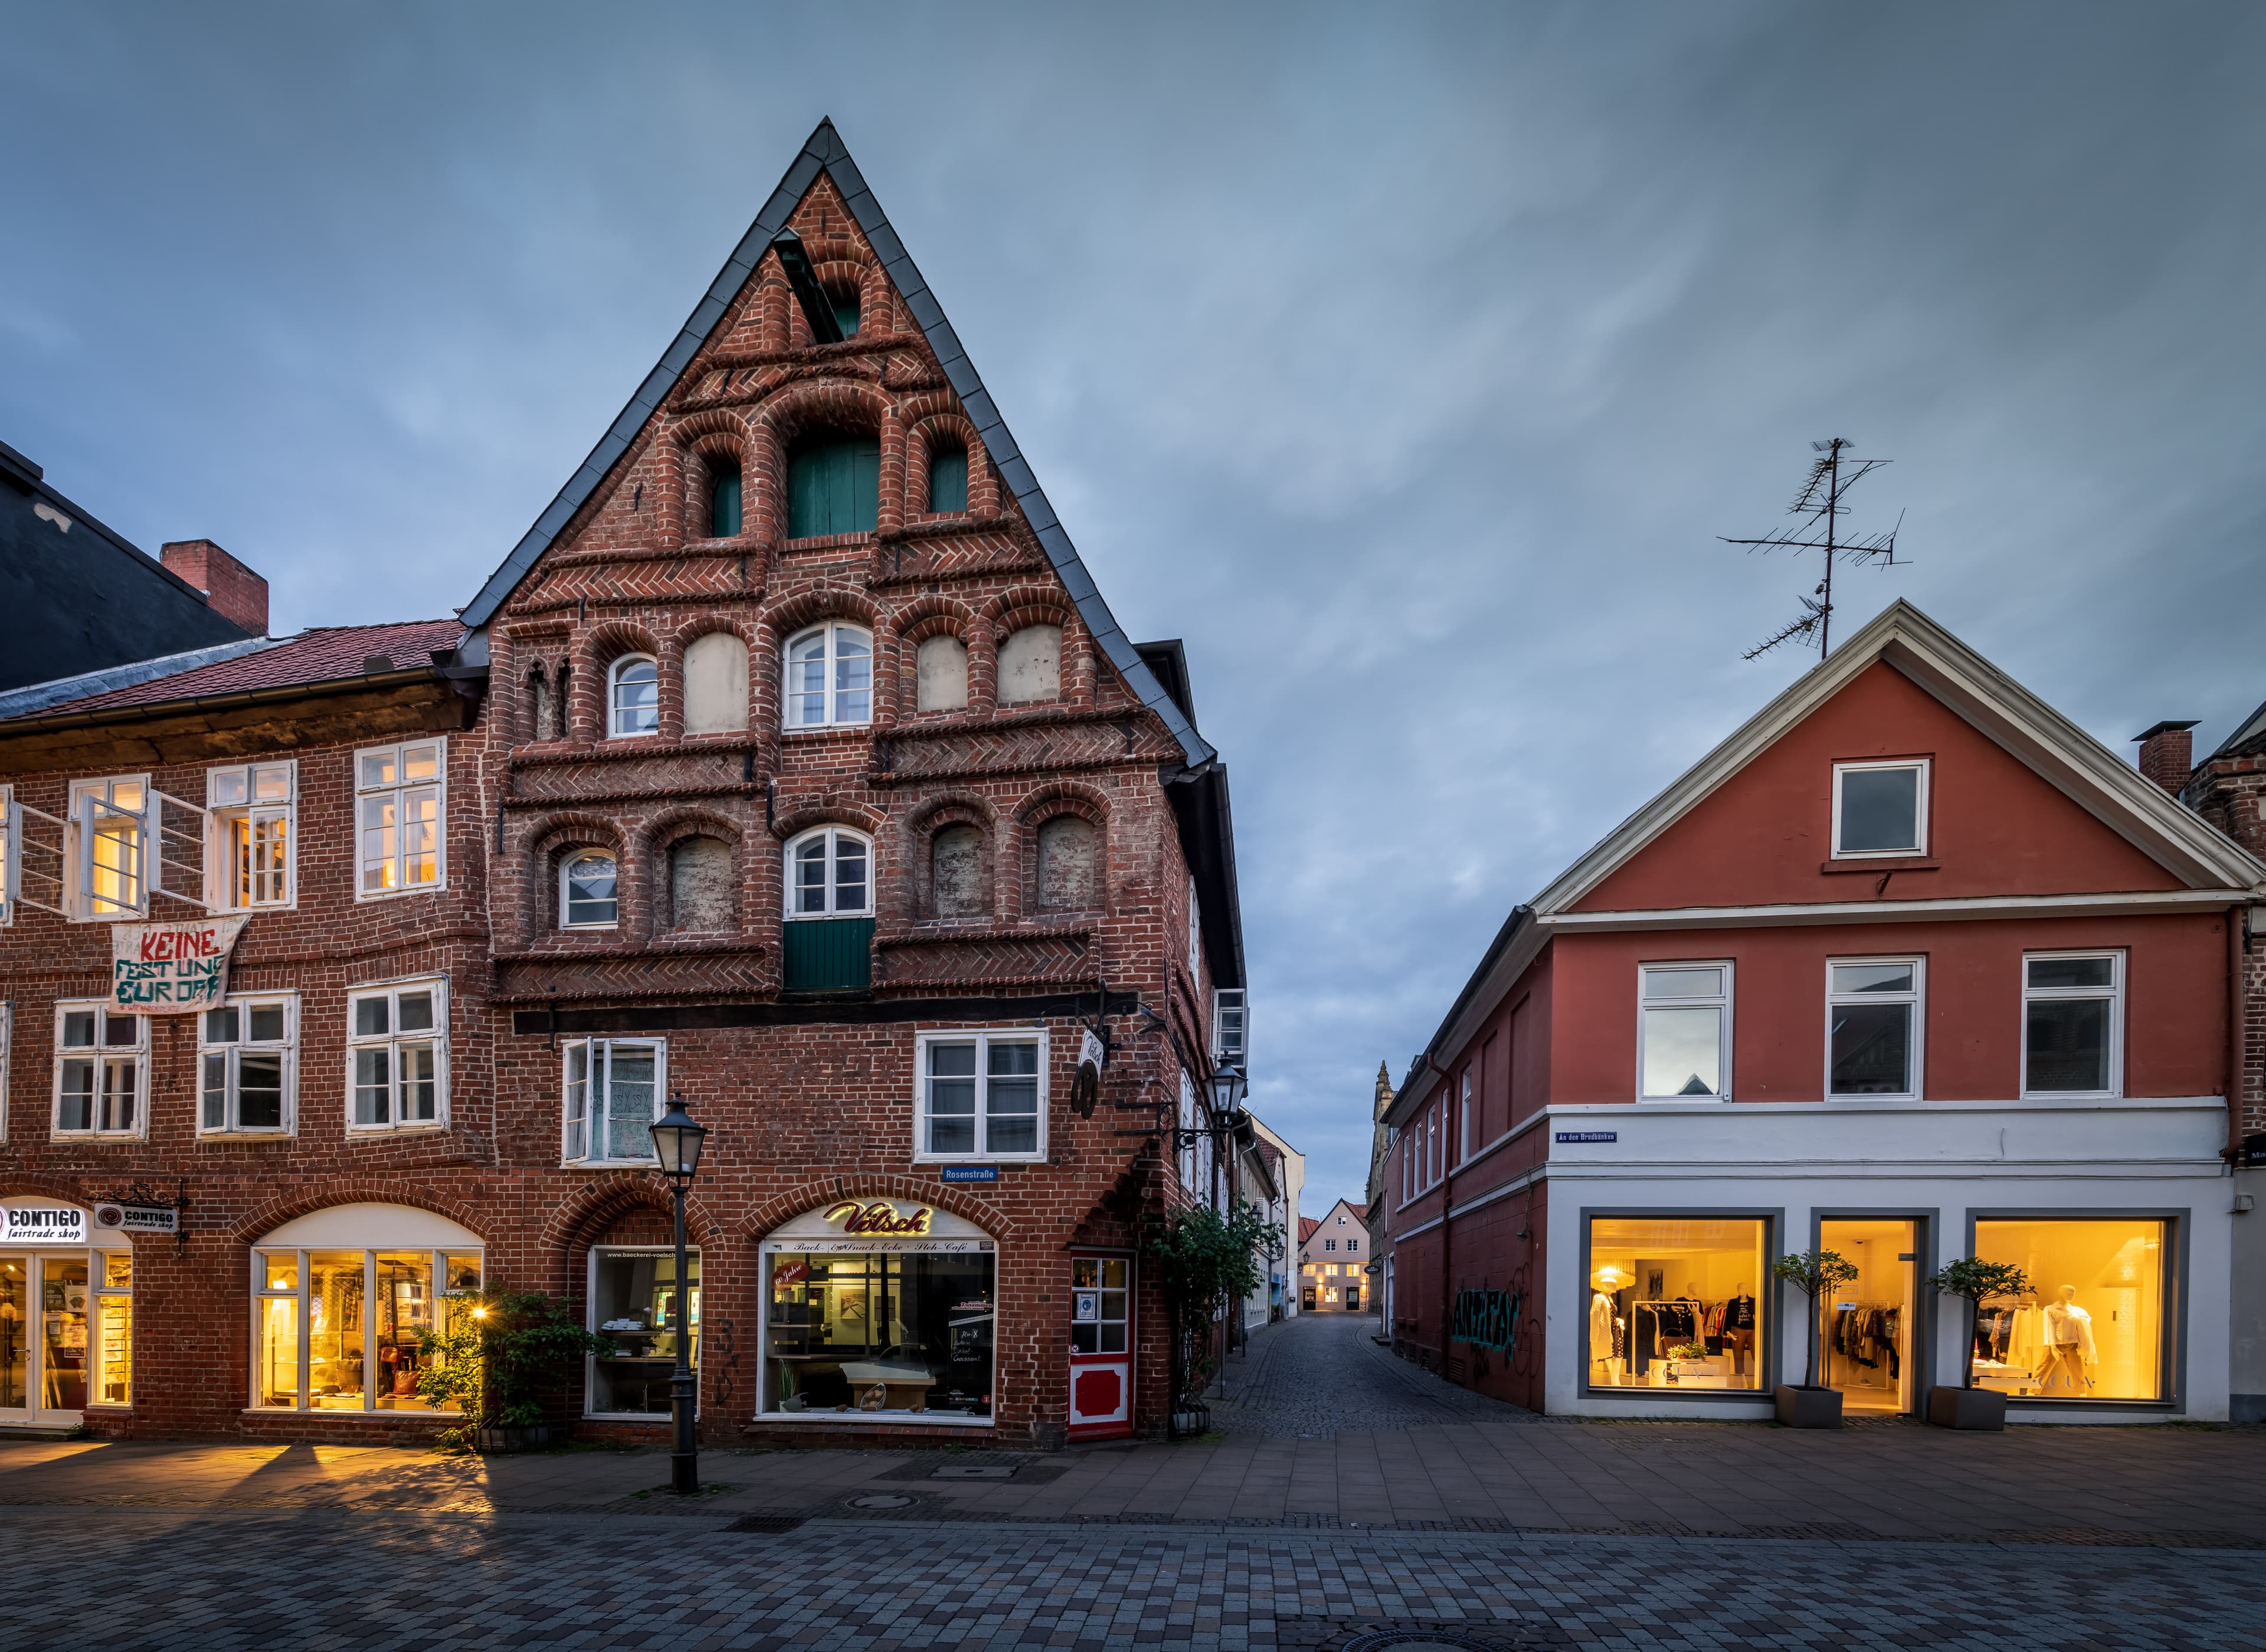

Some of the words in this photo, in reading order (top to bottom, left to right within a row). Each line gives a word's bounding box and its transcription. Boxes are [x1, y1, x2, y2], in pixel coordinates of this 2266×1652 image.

[140, 929, 220, 961] KEINE
[1086, 1035, 1102, 1065] Völsch
[946, 1170, 994, 1178] Rosenstraße
[9, 1210, 81, 1227] CONTIGO
[123, 1219, 156, 1227] fairtrade
[125, 1211, 173, 1222] CONTIGO
[823, 1201, 928, 1233] Völsch
[6, 1228, 54, 1240] fairtrade
[57, 1229, 81, 1240] shop
[794, 1242, 825, 1251] Back-
[775, 1276, 783, 1285] 60
[783, 1264, 803, 1283] Jahre
